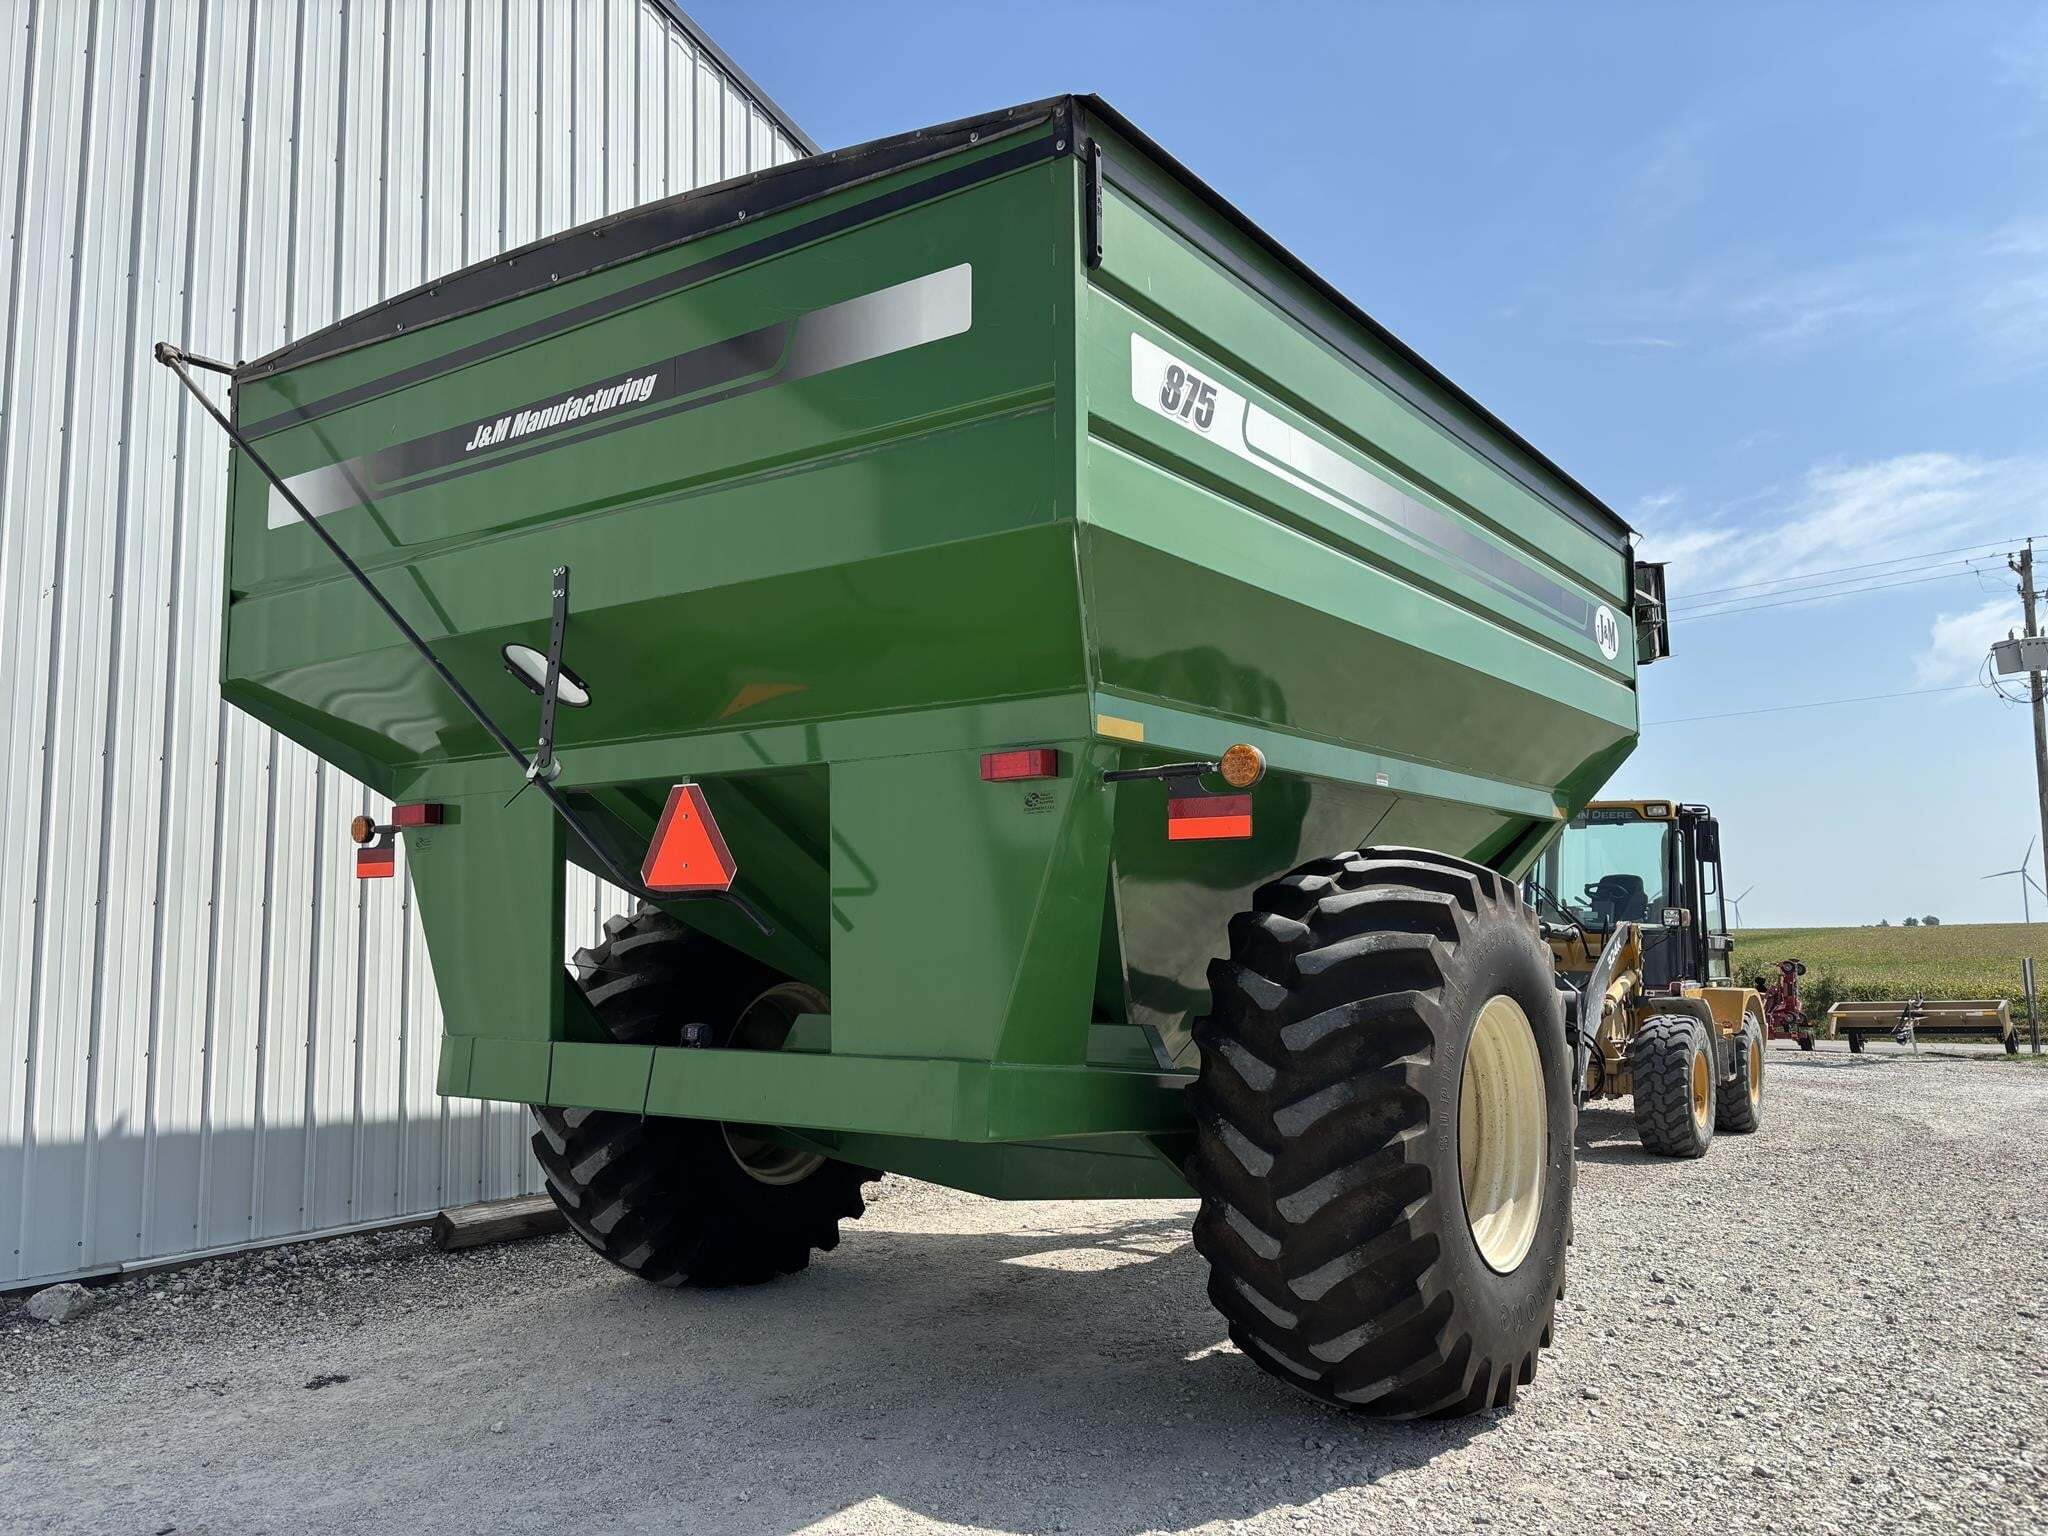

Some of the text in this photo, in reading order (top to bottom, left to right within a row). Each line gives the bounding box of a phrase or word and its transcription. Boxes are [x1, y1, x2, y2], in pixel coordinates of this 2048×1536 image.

[465, 373, 658, 452] J&M Manufacturing
[1160, 364, 1218, 430] 875
[1596, 613, 1617, 652] J&M
[1592, 810, 1633, 820] DEERE
